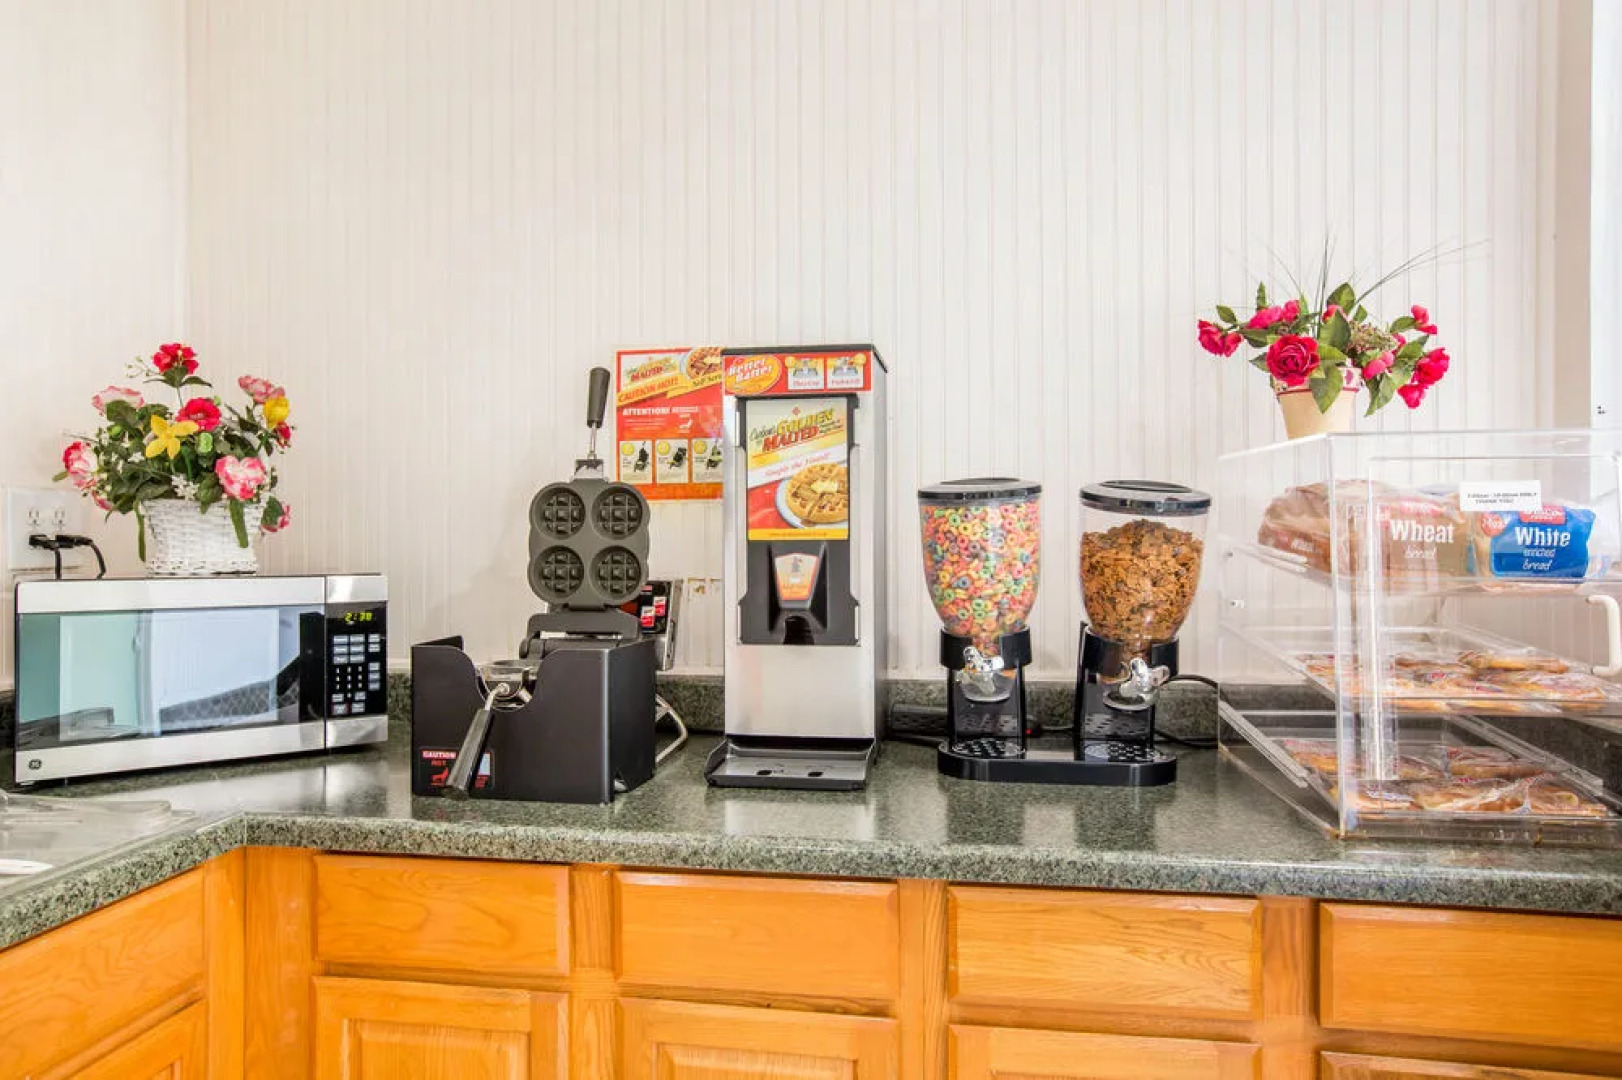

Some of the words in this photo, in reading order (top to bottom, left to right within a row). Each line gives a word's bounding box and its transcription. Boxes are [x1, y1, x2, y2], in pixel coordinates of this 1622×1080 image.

[776, 408, 835, 435] GOLDEN
[761, 424, 820, 452] MALTED
[1389, 518, 1455, 544] Wheat
[1514, 526, 1571, 547] White
[1404, 545, 1438, 560] bread
[1522, 558, 1554, 571] bread
[422, 751, 457, 759] CAUTION
